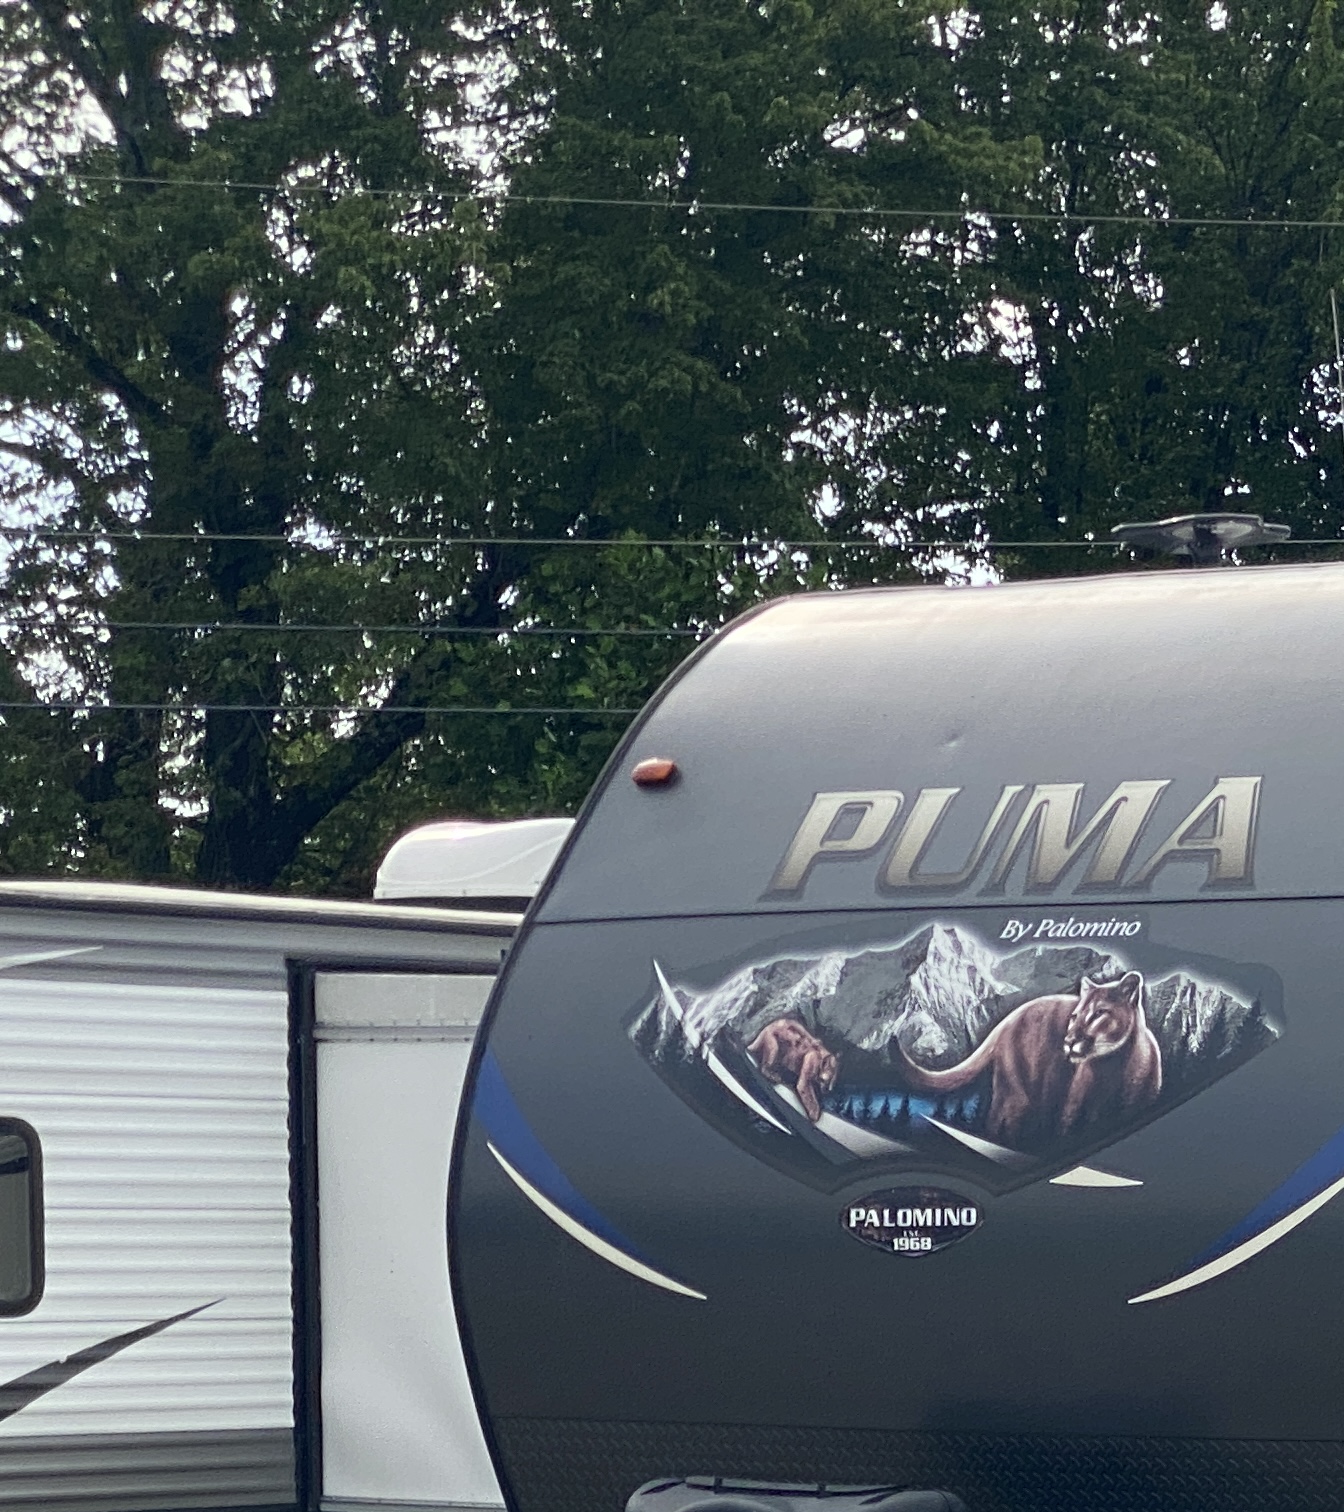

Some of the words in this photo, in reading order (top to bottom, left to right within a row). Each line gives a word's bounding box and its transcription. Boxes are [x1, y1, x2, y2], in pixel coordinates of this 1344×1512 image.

[760, 776, 1263, 899] PUMA
[1000, 919, 1033, 943] By
[1033, 917, 1141, 938] Palomino
[849, 1207, 977, 1228] PALOMINO
[893, 1237, 932, 1251] 1968
